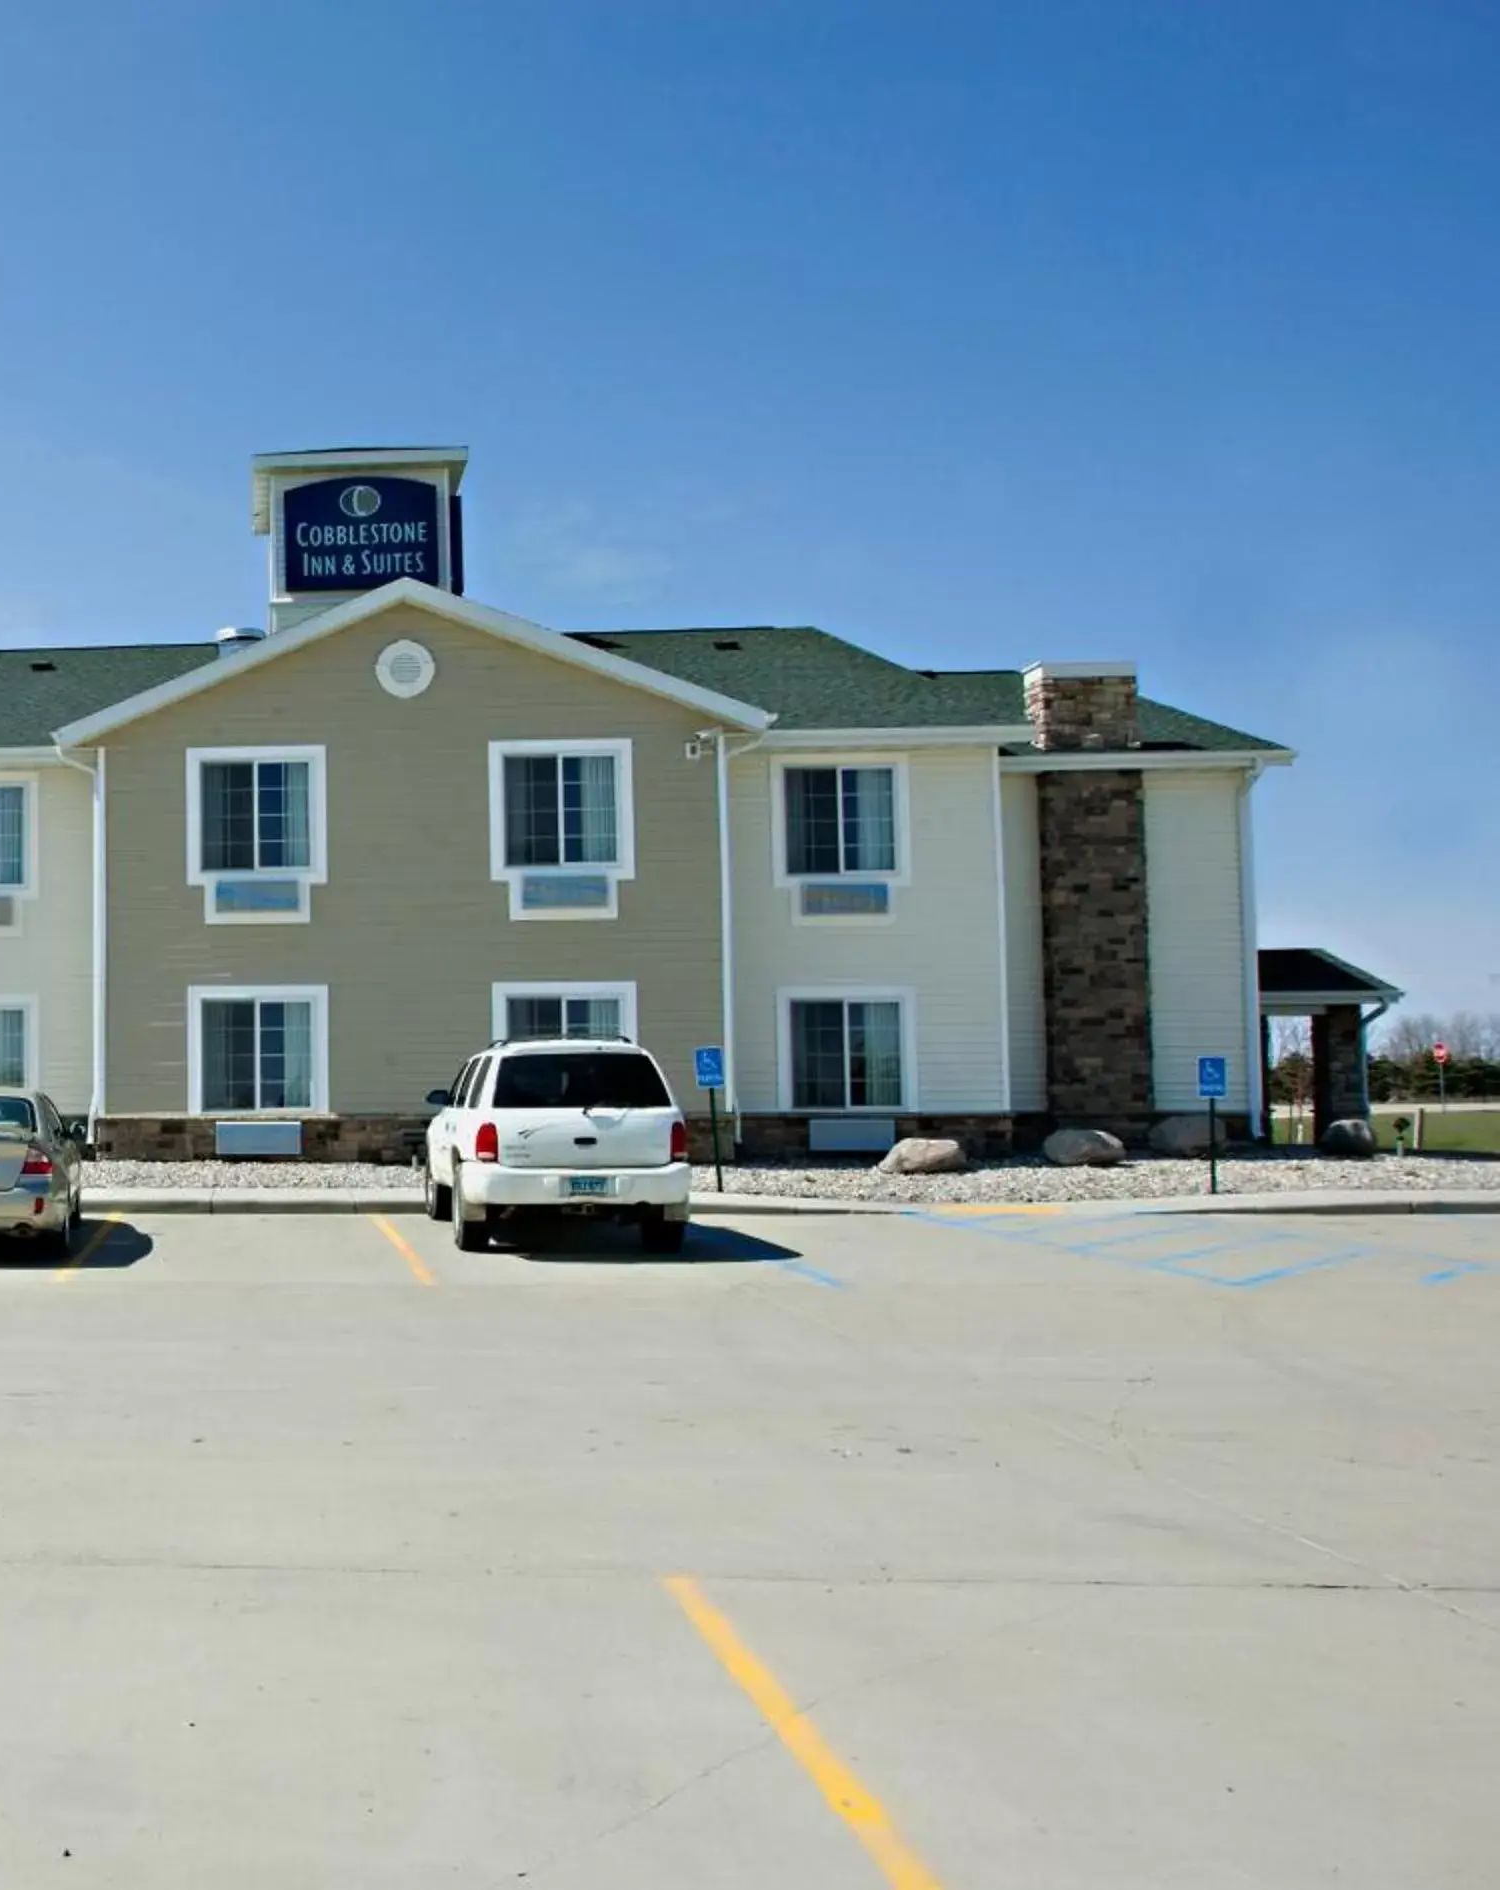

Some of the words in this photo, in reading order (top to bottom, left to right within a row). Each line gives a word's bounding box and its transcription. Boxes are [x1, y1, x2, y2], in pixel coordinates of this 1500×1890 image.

[296, 521, 429, 547] COBBLESTONE
[303, 551, 337, 577] INN
[342, 553, 356, 576] &
[361, 549, 426, 575] SUITES
